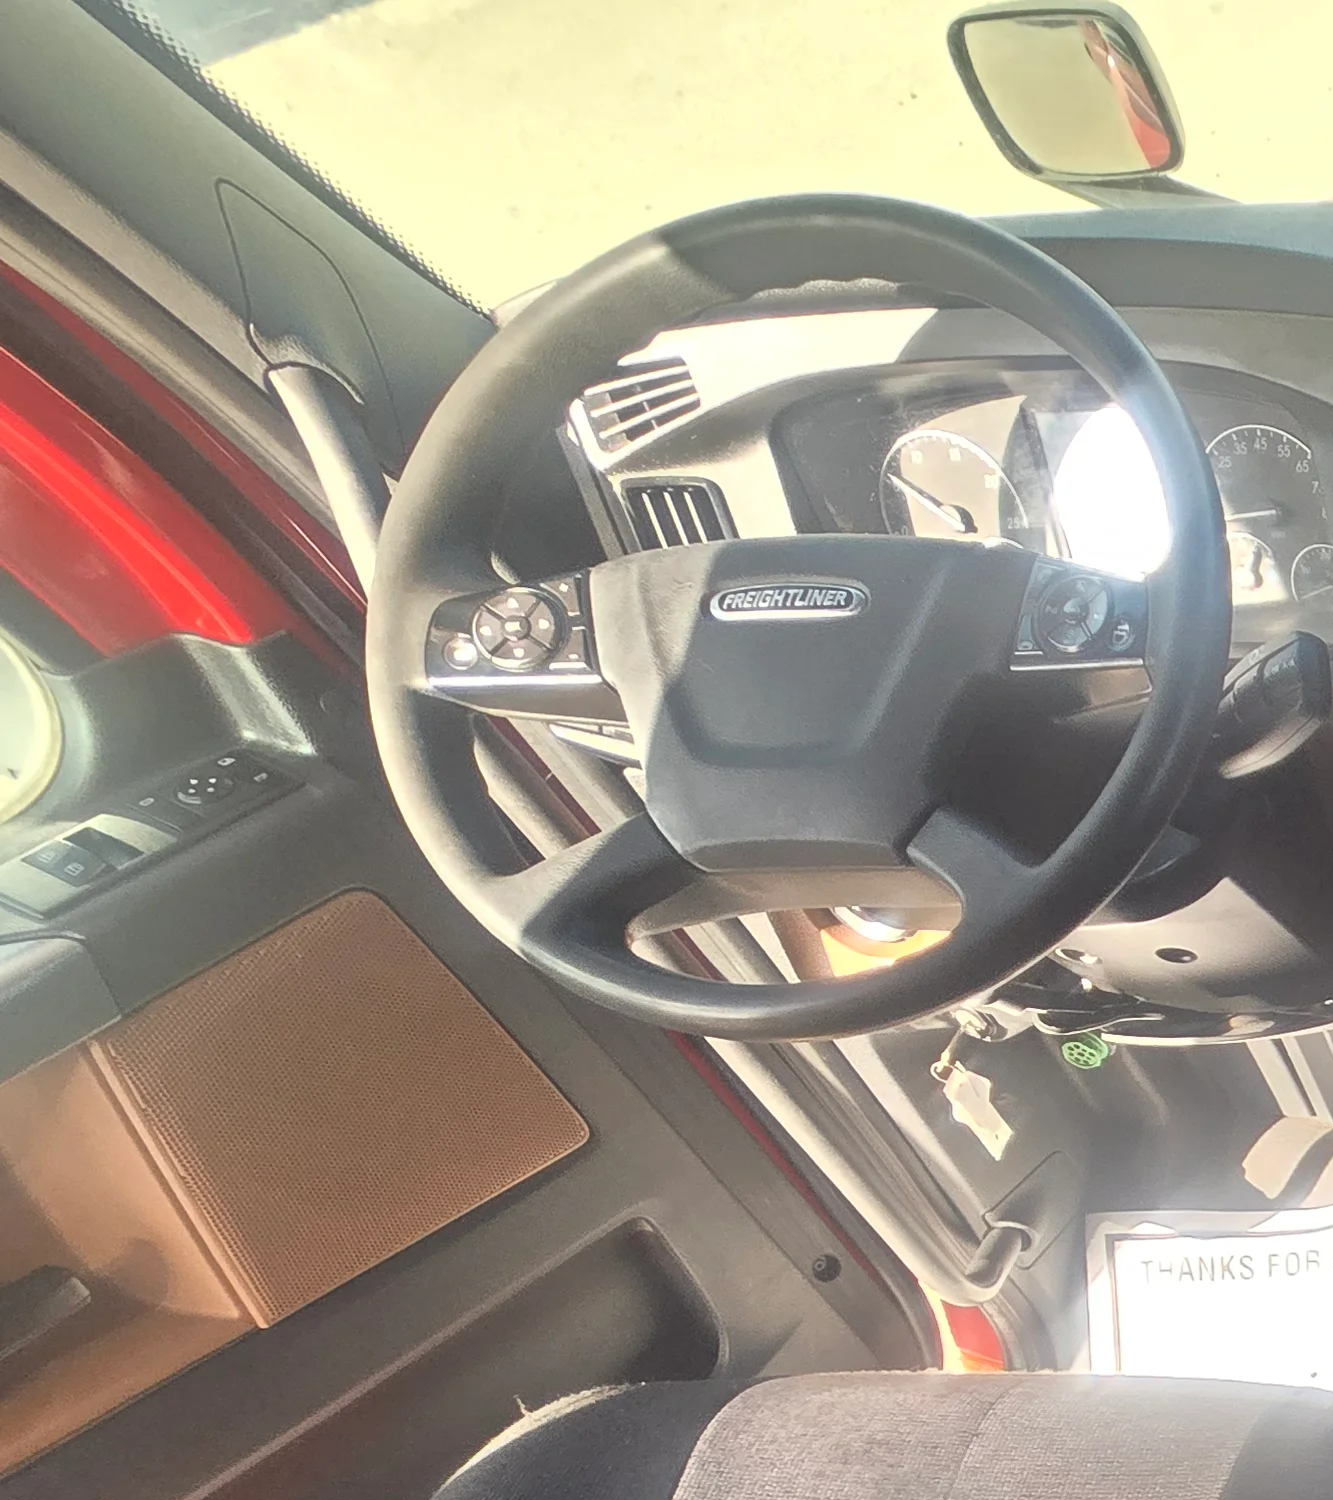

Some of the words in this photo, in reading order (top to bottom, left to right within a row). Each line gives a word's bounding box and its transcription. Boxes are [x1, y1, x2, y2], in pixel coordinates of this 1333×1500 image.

[1233, 442, 1247, 455] 35
[1253, 436, 1267, 450] 45
[1277, 445, 1290, 458] 55
[1217, 456, 1232, 468] 25
[1295, 460, 1309, 472] 65
[722, 589, 848, 610] FREIGHTLINER
[1268, 1250, 1319, 1277] FOR
